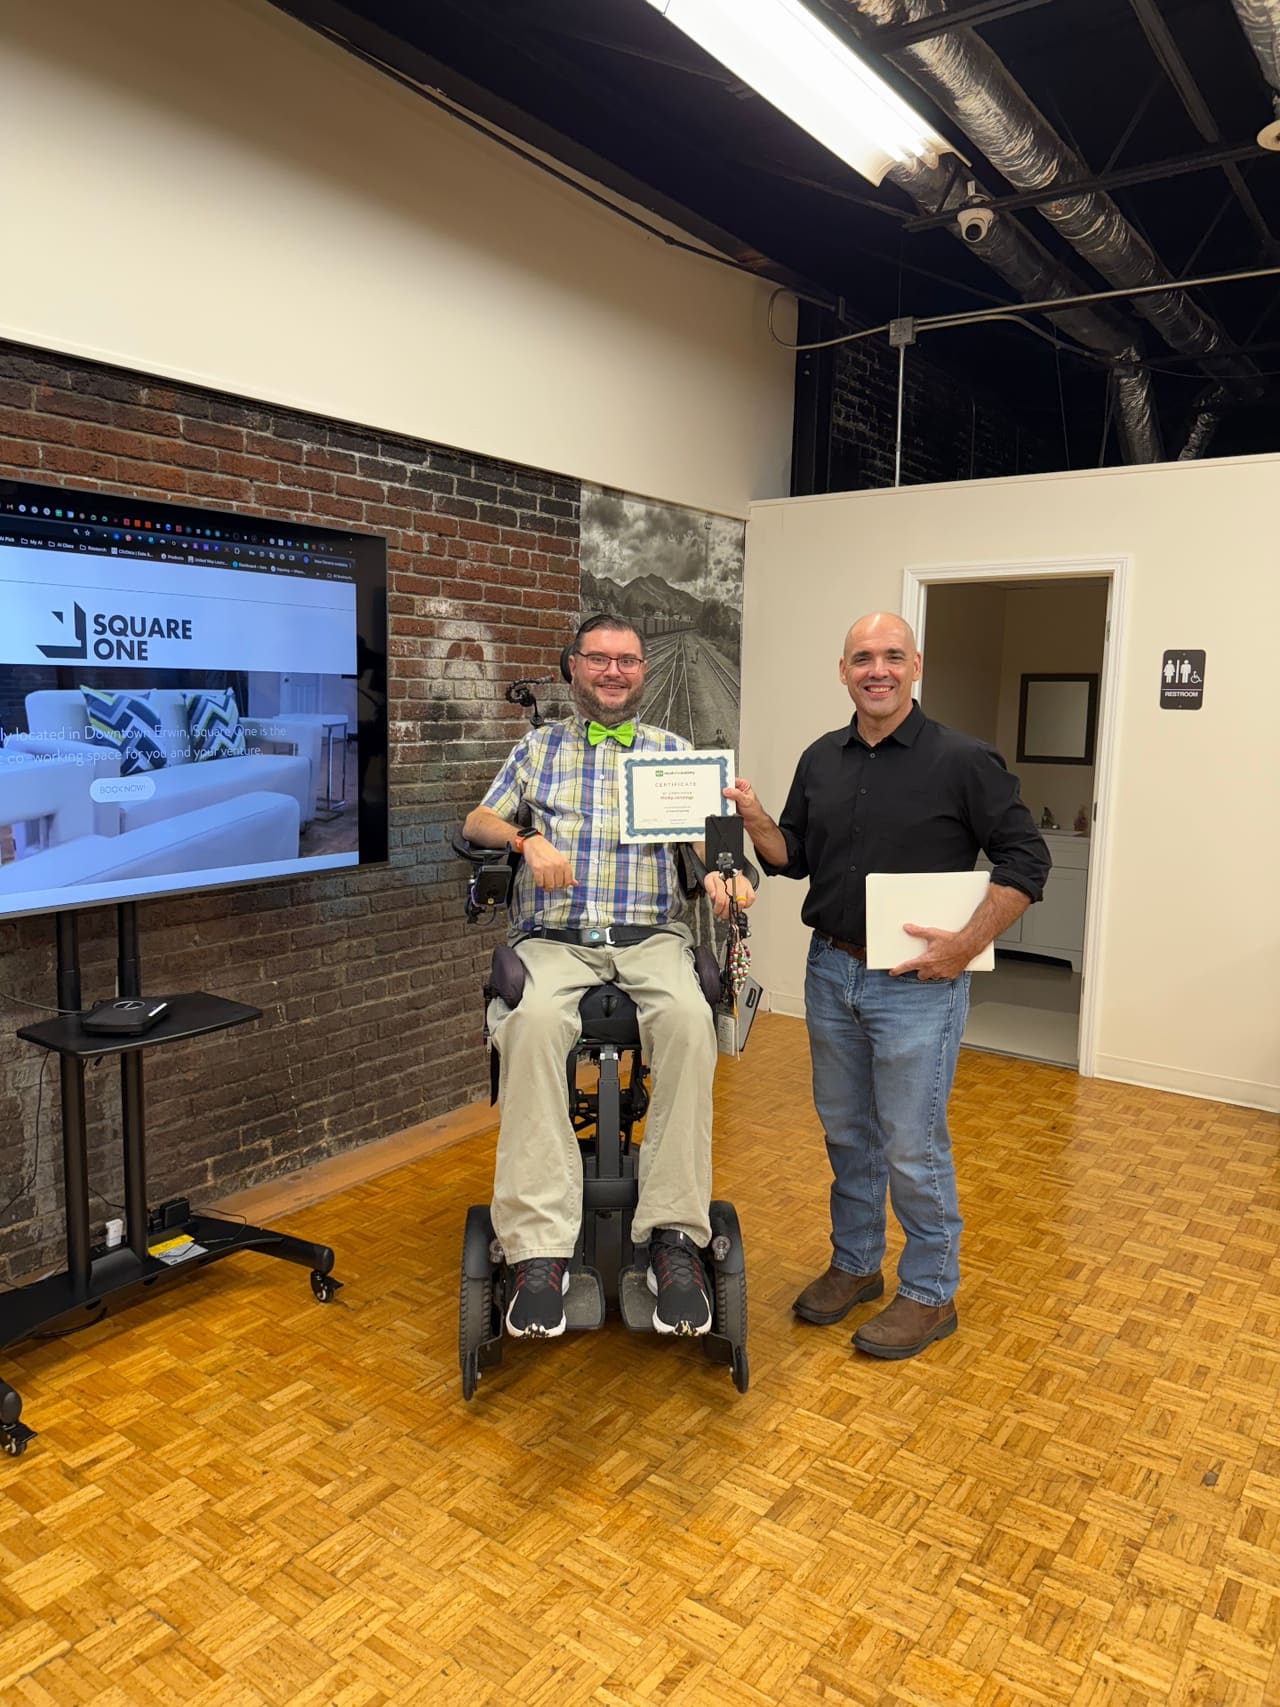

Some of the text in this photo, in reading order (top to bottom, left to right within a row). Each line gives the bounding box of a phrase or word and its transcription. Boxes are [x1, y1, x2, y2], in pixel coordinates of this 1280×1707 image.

[93, 613, 193, 640] SQUARE
[93, 638, 149, 661] ONE
[16, 726, 65, 741] located
[69, 726, 80, 740] in
[84, 724, 150, 740] Downtown
[192, 723, 231, 739] Square
[234, 724, 258, 737] One
[260, 723, 267, 736] is
[269, 722, 288, 736] the
[87, 751, 122, 766] space
[126, 746, 143, 760] for
[145, 748, 167, 762] you
[170, 744, 191, 758] and
[193, 748, 217, 761] your
